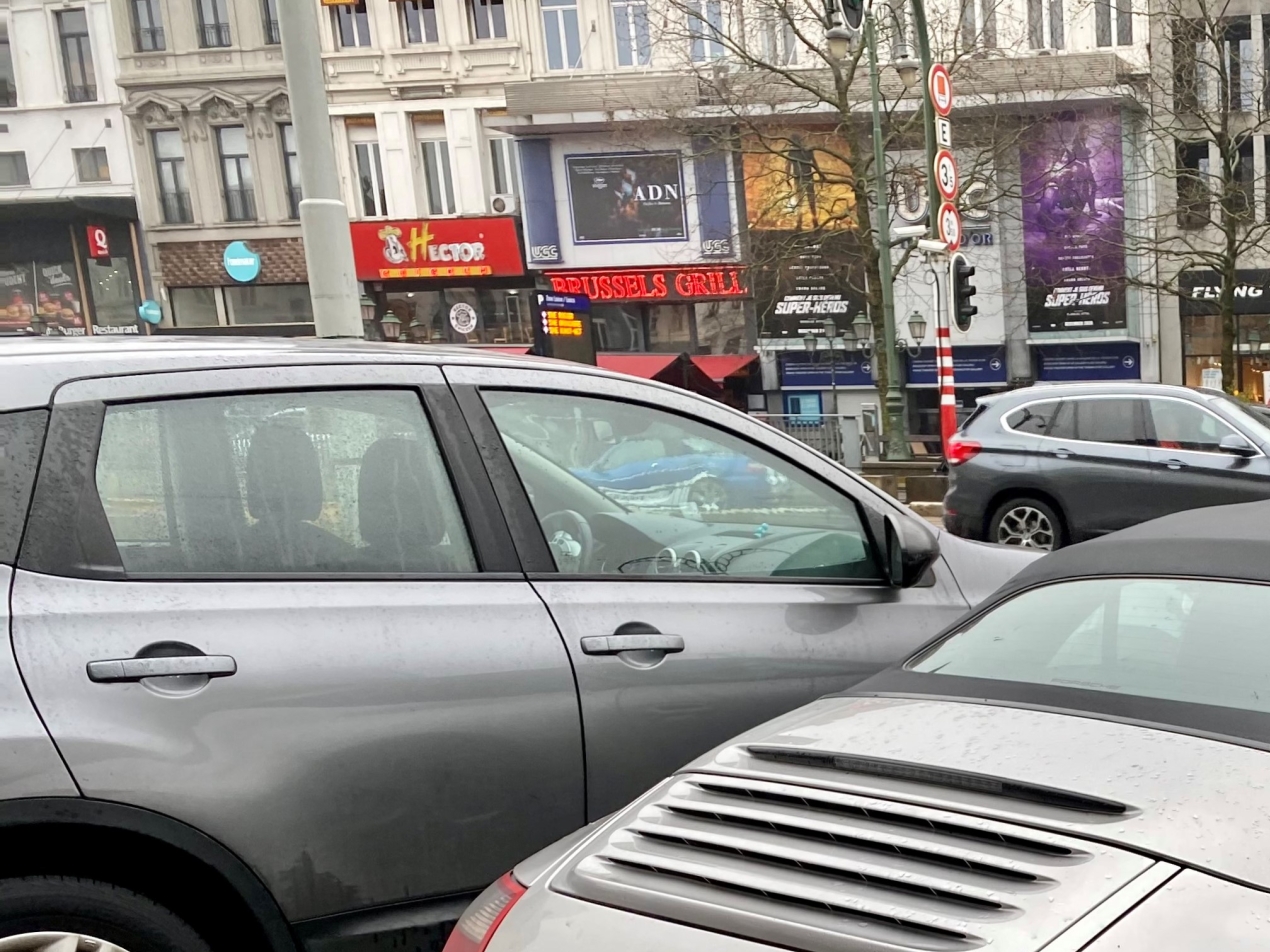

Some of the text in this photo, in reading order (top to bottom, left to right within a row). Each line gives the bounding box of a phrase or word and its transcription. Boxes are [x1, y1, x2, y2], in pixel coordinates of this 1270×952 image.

[941, 123, 948, 143] E
[634, 184, 679, 201] ADN
[94, 229, 108, 248] Q
[407, 222, 486, 263] HECTOR
[702, 240, 730, 254] UGC
[531, 245, 559, 259] UGC
[551, 270, 748, 299] BRUSSELS GRILL
[1191, 285, 1264, 298] FLYNG
[92, 324, 139, 335] Restaurant
